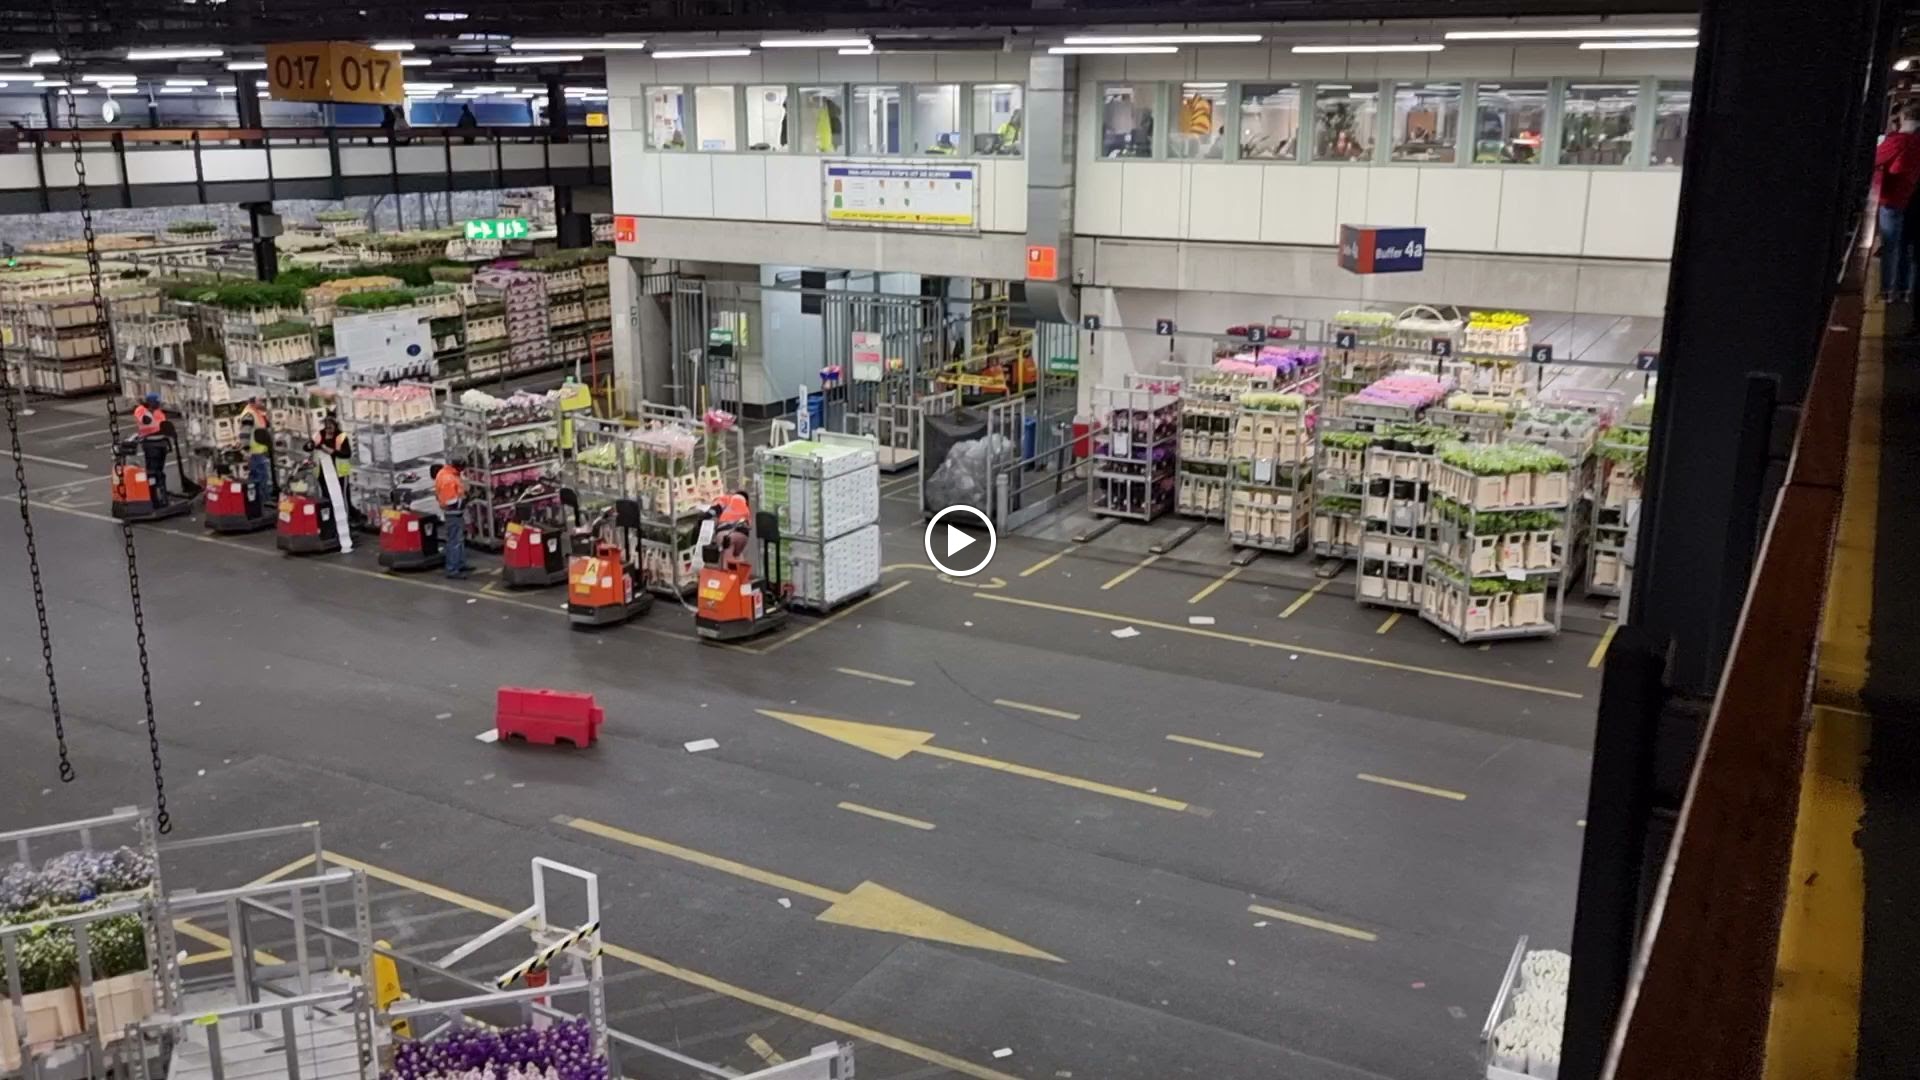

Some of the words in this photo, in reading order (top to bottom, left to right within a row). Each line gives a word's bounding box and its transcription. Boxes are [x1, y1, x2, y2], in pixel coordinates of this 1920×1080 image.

[275, 55, 320, 89] 017
[340, 56, 391, 91] 017
[1375, 246, 1403, 260] Buffer
[1404, 240, 1423, 258] 4a
[1088, 317, 1095, 329] 1
[1161, 322, 1168, 334] 2
[1253, 329, 1260, 340] 3
[1341, 335, 1350, 347] 4
[1436, 342, 1445, 354] 5
[1537, 349, 1547, 361] 6
[1643, 356, 1653, 369] 7
